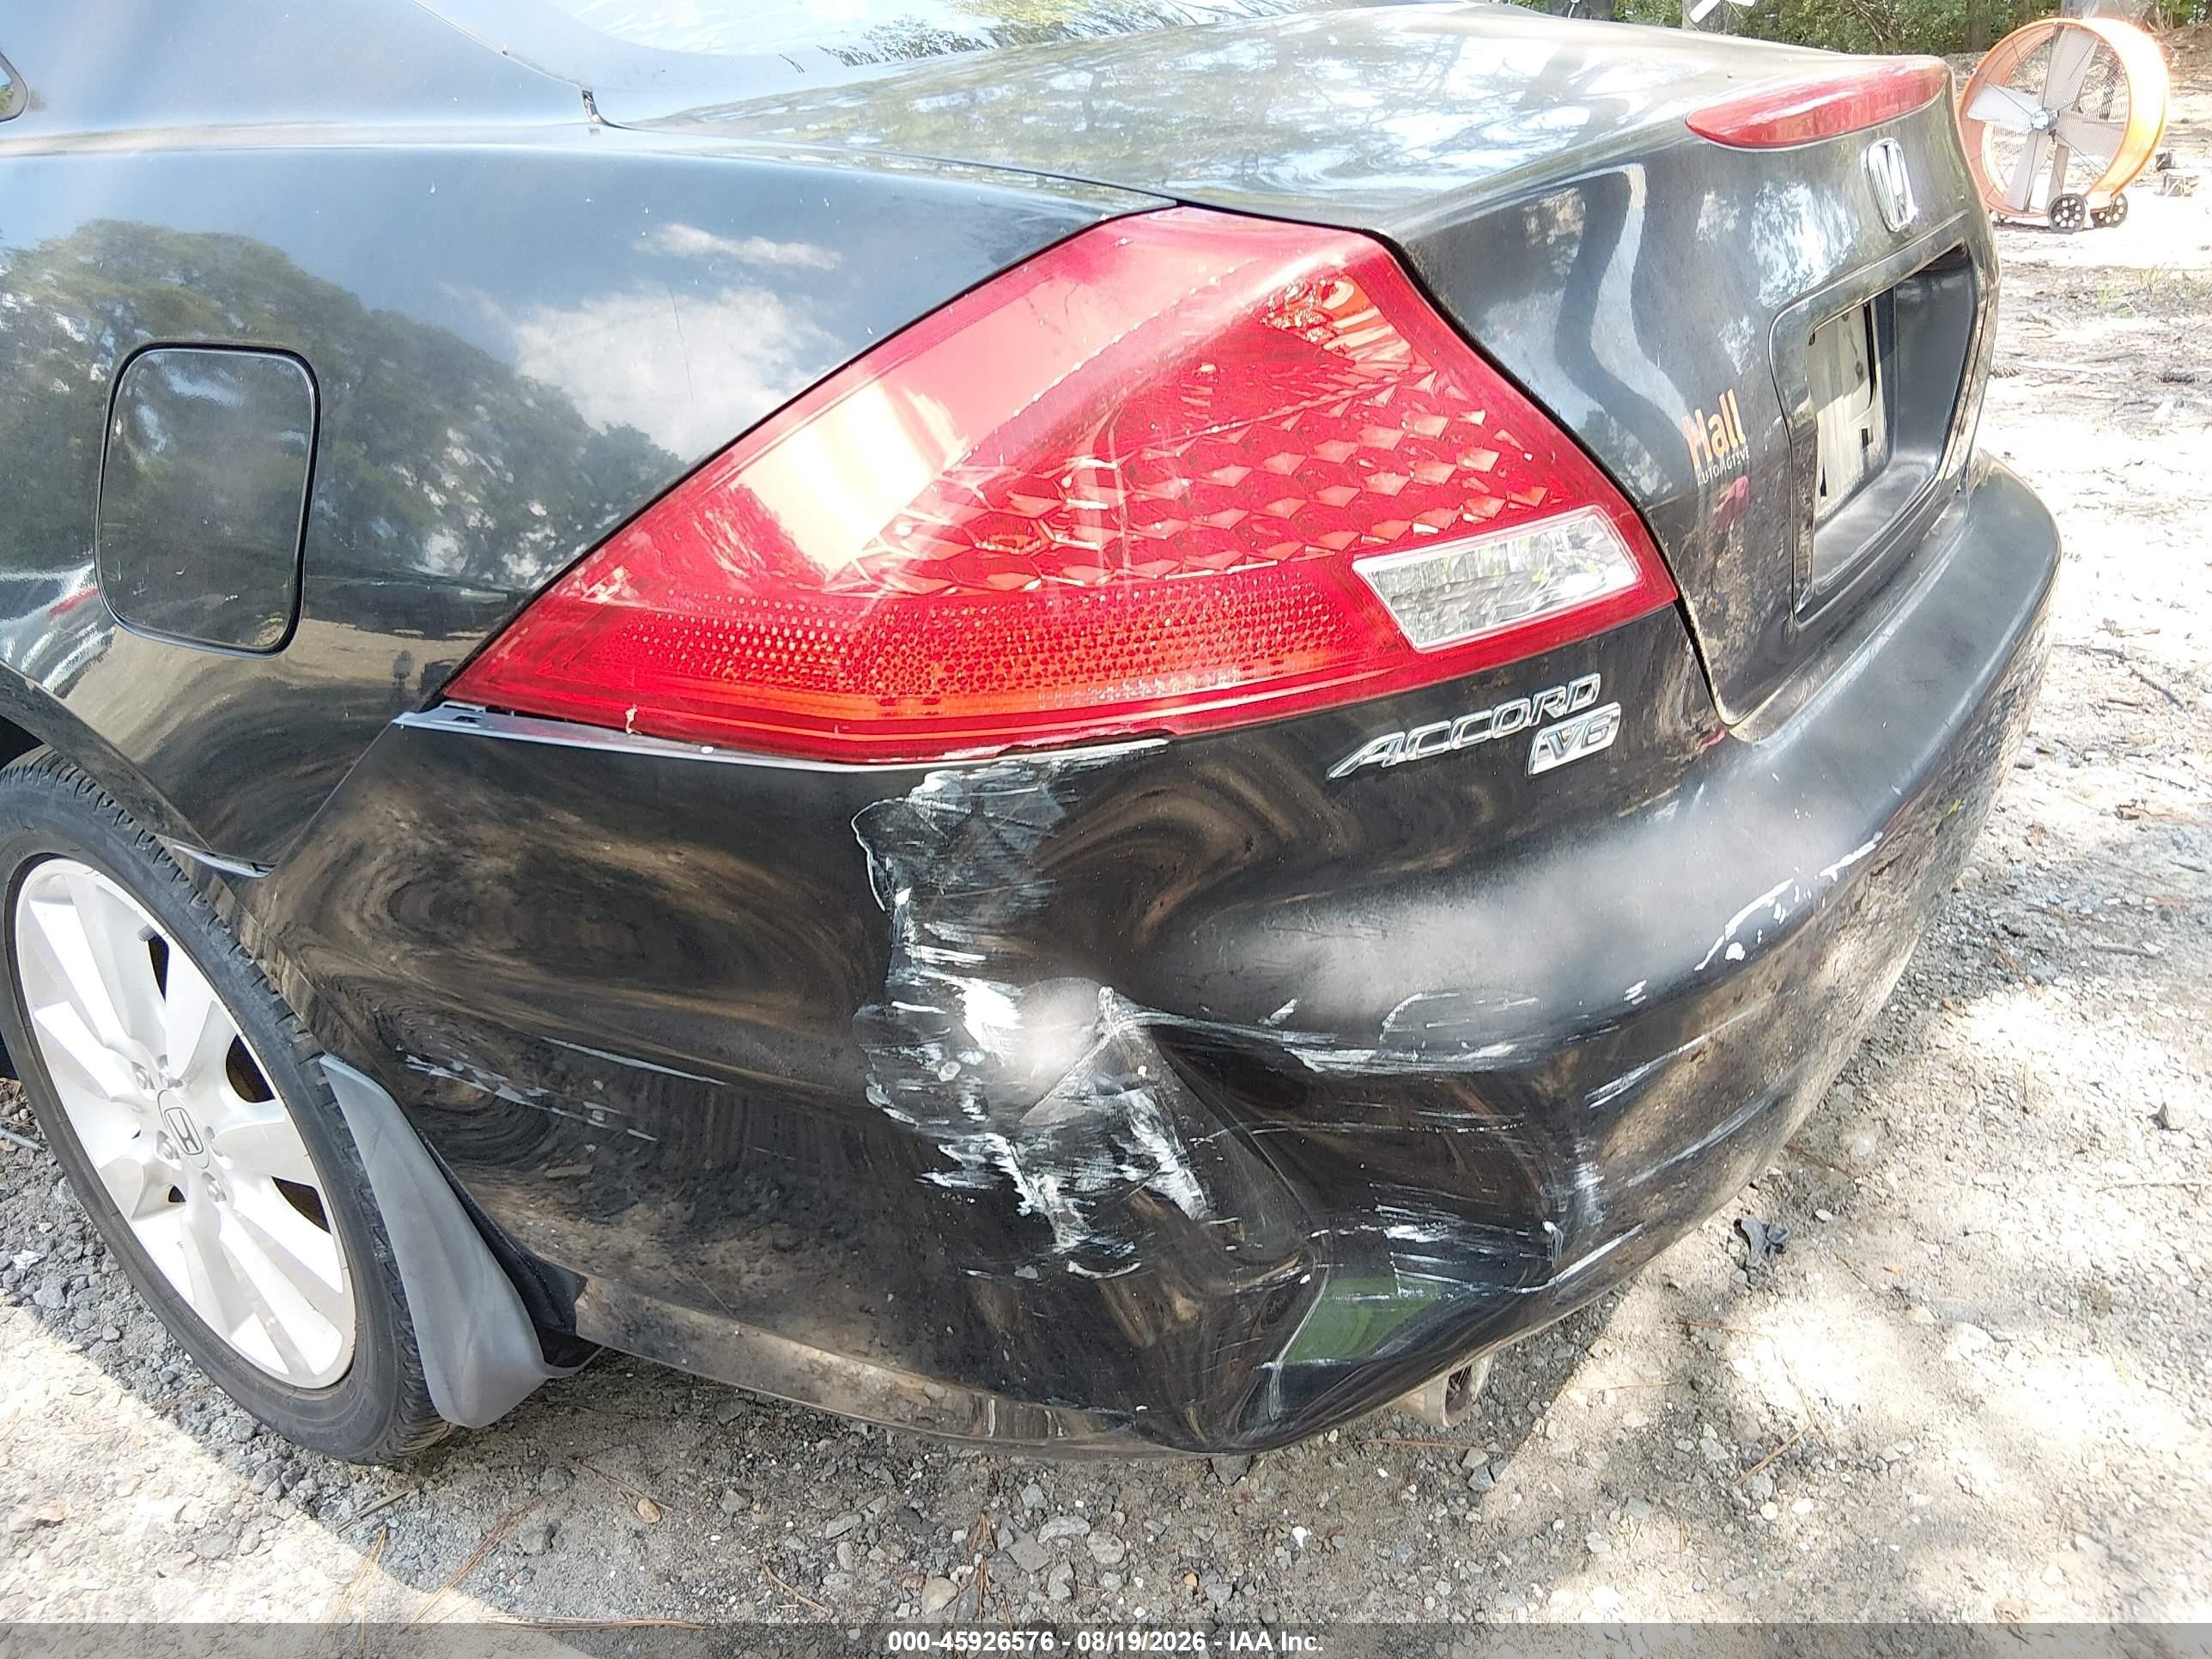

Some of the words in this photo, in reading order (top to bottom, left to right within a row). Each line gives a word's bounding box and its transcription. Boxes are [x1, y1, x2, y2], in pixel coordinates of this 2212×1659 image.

[1681, 388, 1747, 468] Hall
[1327, 672, 1601, 778] ACCORD
[1542, 712, 1614, 762] V6
